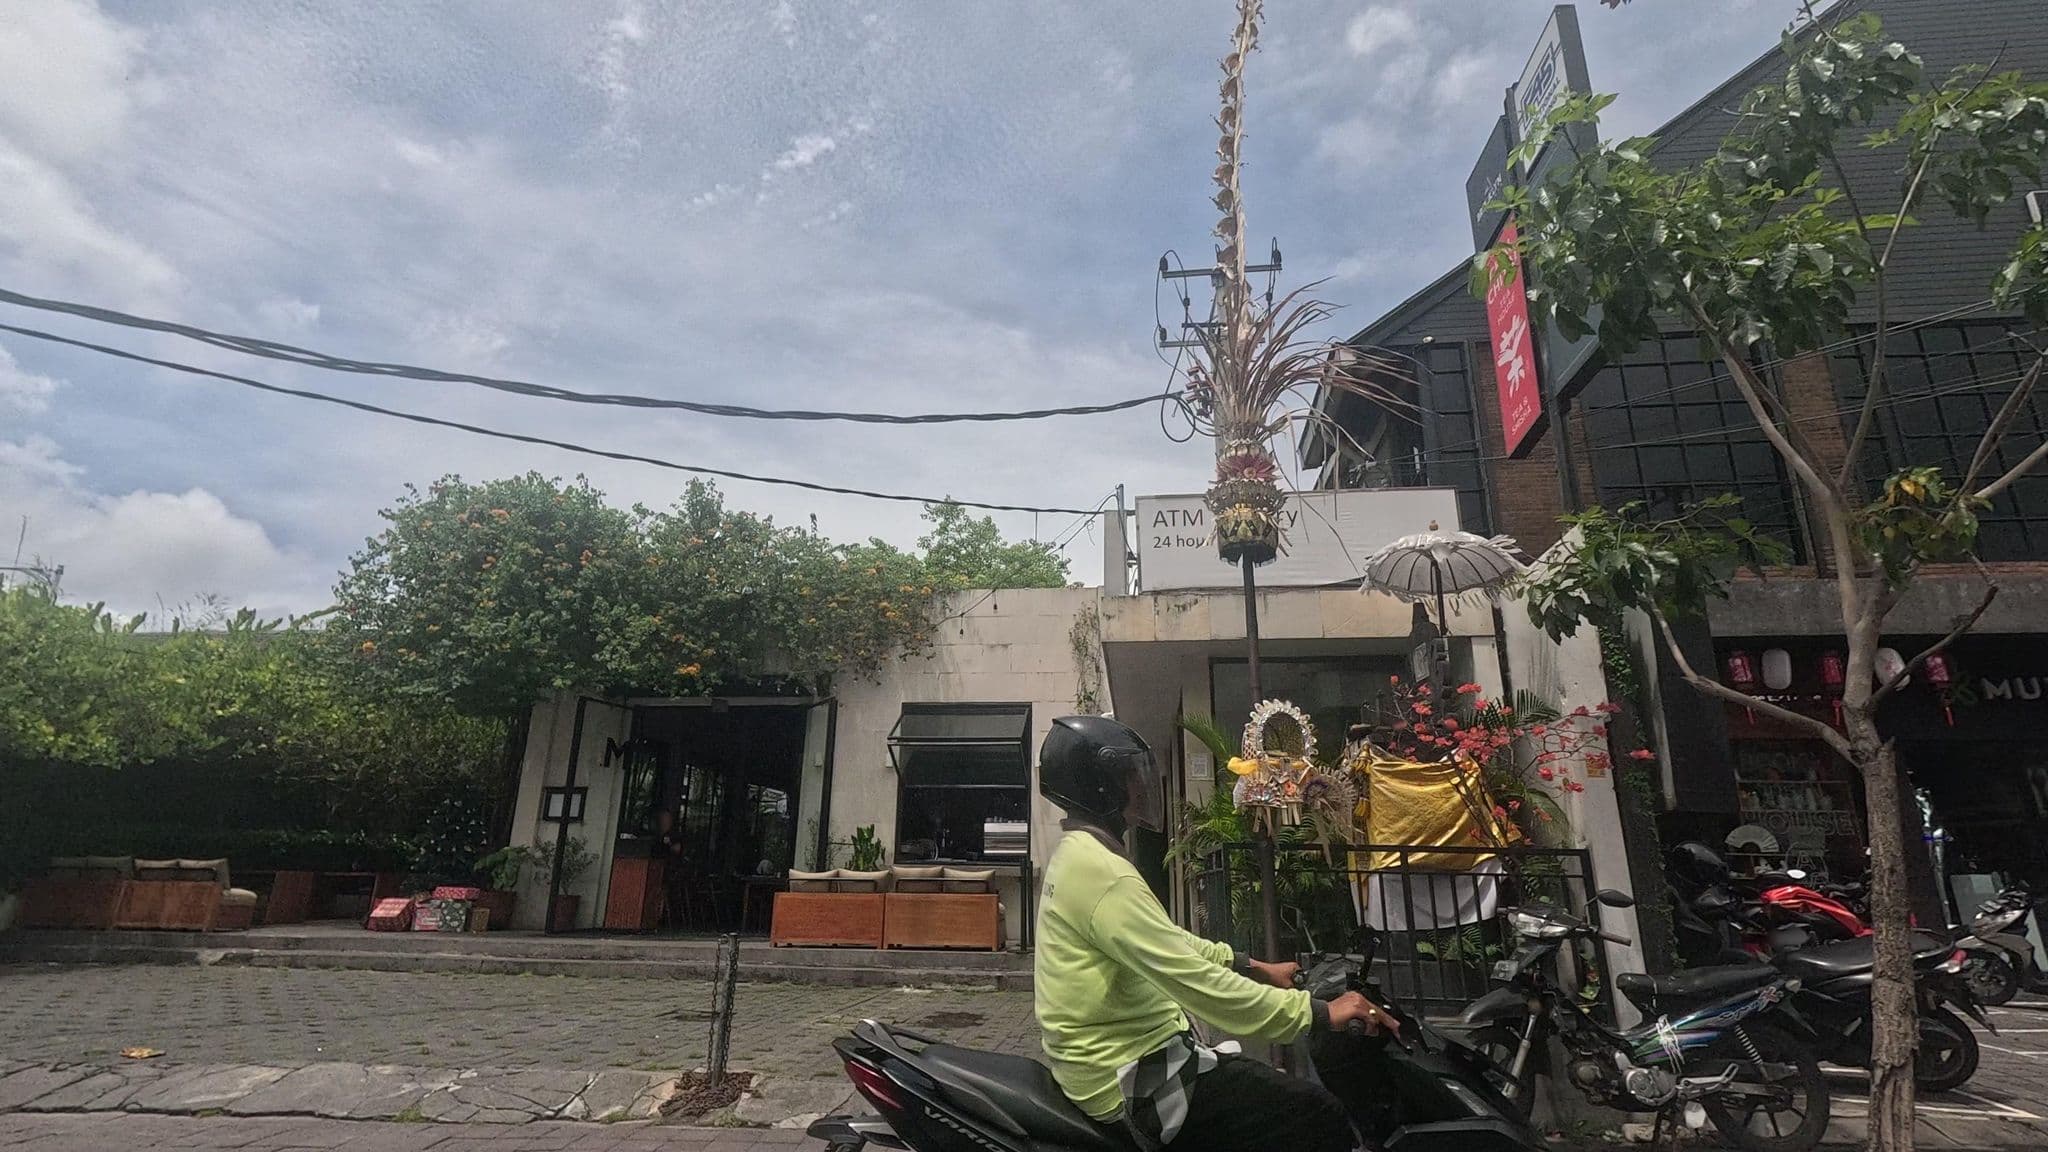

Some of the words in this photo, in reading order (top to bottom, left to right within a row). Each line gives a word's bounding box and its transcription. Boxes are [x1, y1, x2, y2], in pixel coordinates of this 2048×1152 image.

[1153, 508, 1204, 528] ATM
[1153, 535, 1172, 549] 24
[1979, 675, 2048, 701] MU
[923, 1105, 1006, 1152] VARIO
